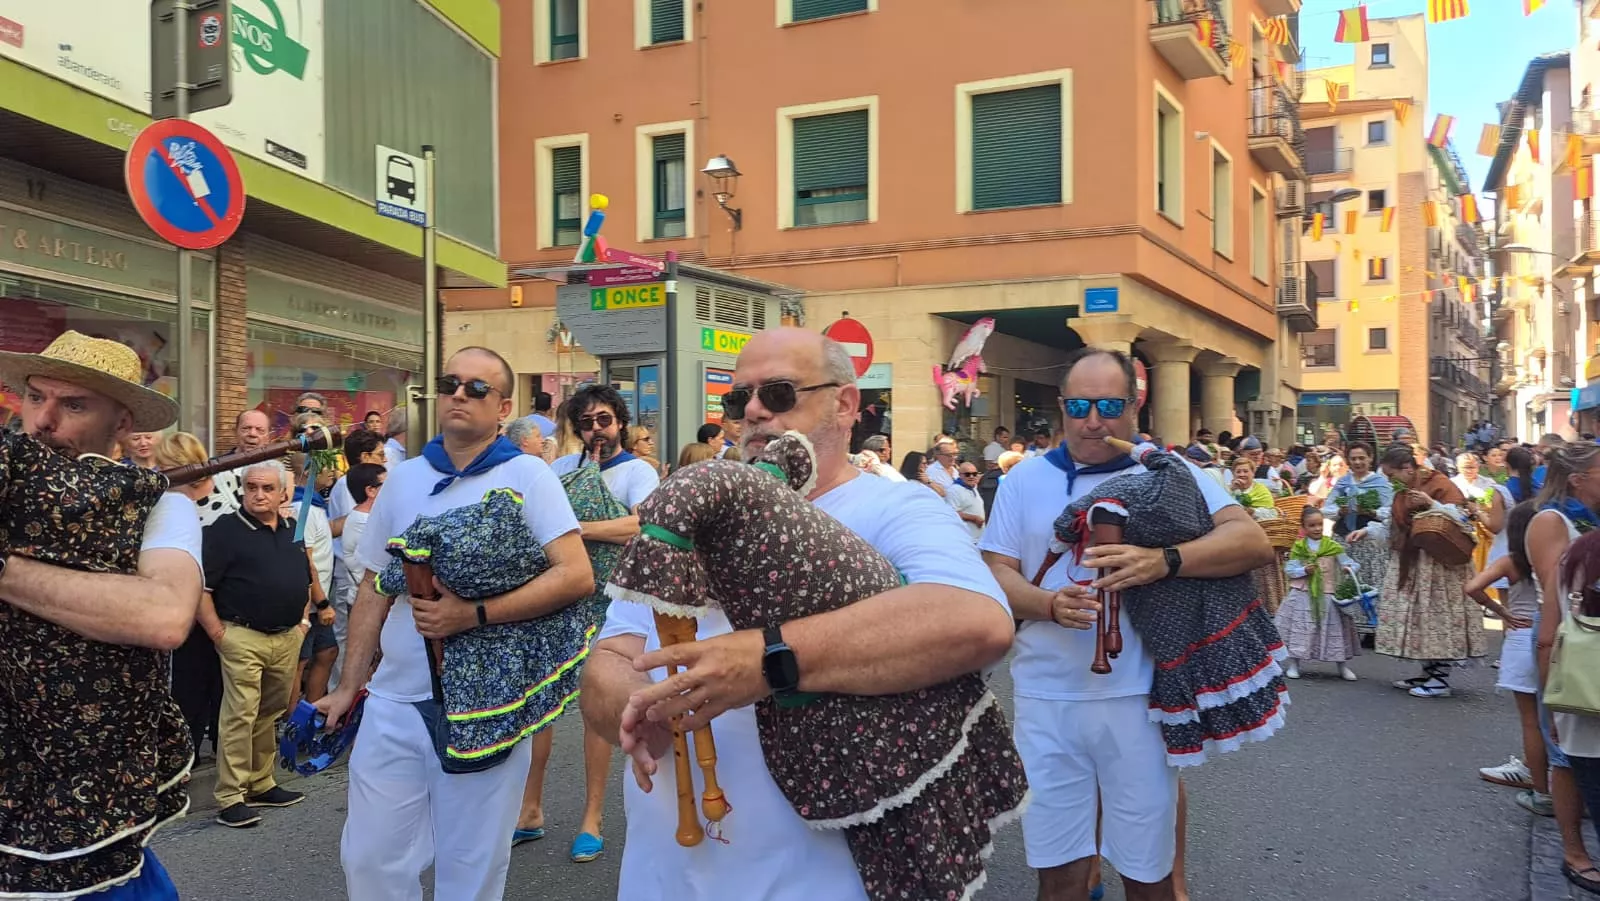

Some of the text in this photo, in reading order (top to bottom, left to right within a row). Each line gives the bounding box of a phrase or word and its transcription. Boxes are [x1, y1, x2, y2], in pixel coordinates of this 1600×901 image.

[232, 13, 273, 52] ÑOS
[13, 228, 29, 249] &
[39, 234, 128, 271] ARTERO
[612, 286, 660, 305] ONCE
[720, 334, 748, 350] ONC
